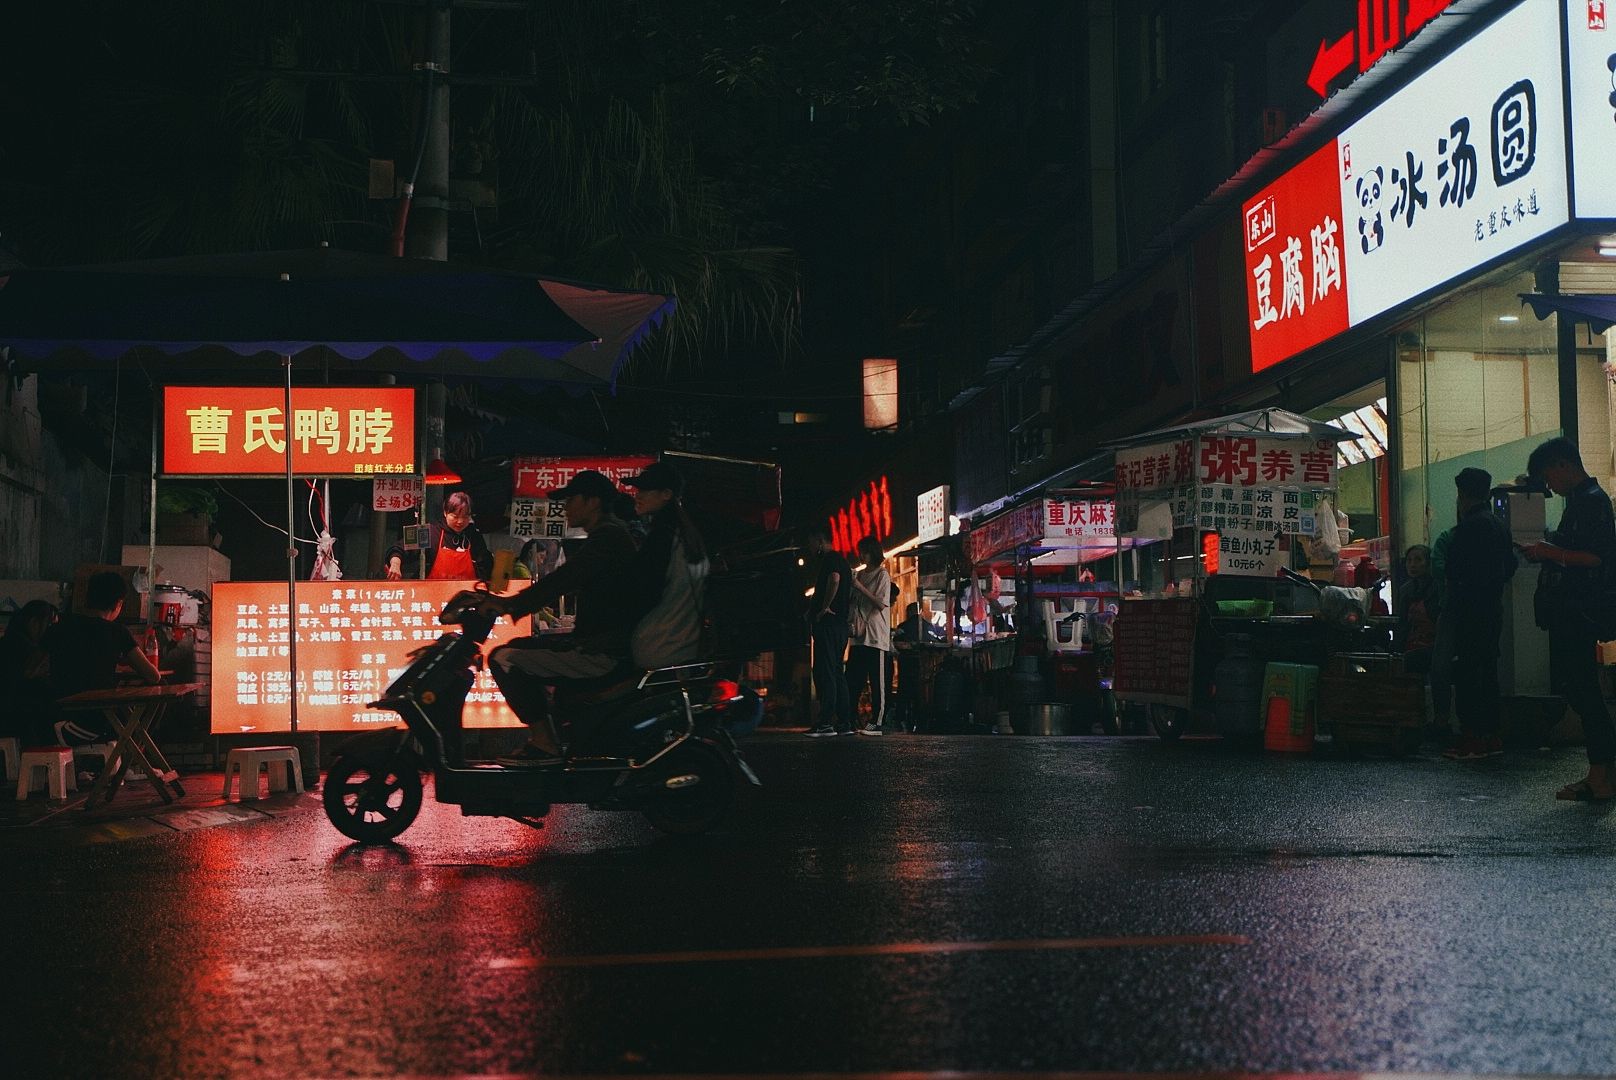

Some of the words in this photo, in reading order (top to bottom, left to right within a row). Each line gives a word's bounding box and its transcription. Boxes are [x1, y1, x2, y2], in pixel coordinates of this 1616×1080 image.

[1390, 79, 1536, 228] 冰汤圆
[1474, 188, 1539, 242] 老重庆味道
[1251, 208, 1271, 241] 乐山
[1253, 216, 1341, 331] 豆腐脑
[186, 406, 393, 454] 曹氏鸭脖
[354, 464, 414, 473] 团结红光分店
[376, 478, 422, 491] 开业期间
[1256, 489, 1298, 504] 凉面
[515, 500, 566, 518] 凉皮
[1256, 506, 1298, 519] 凉皮
[514, 519, 564, 537] 凉面
[1220, 536, 1275, 556] 章鱼小丸子
[1228, 558, 1264, 569] 10元6个
